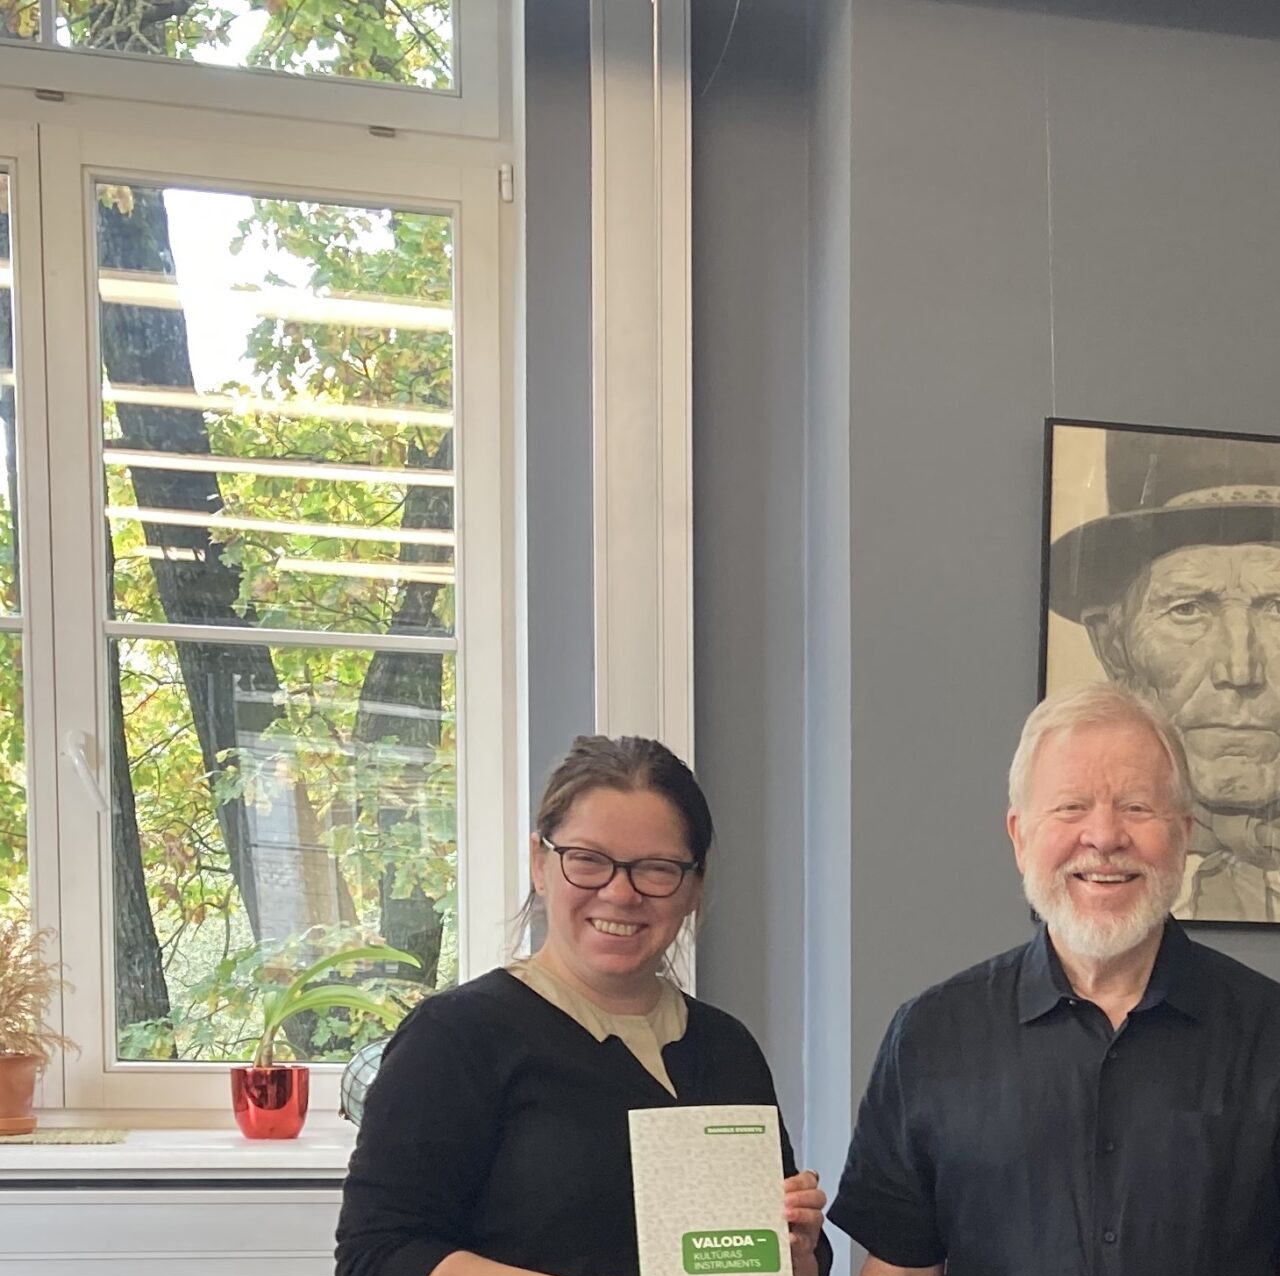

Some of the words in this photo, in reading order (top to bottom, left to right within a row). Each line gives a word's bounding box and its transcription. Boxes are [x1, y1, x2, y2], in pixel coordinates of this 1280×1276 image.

[692, 1235, 754, 1249] VALODA
[693, 1249, 743, 1261] KULTŪRAS
[694, 1258, 762, 1270] INSTRUMENTS
